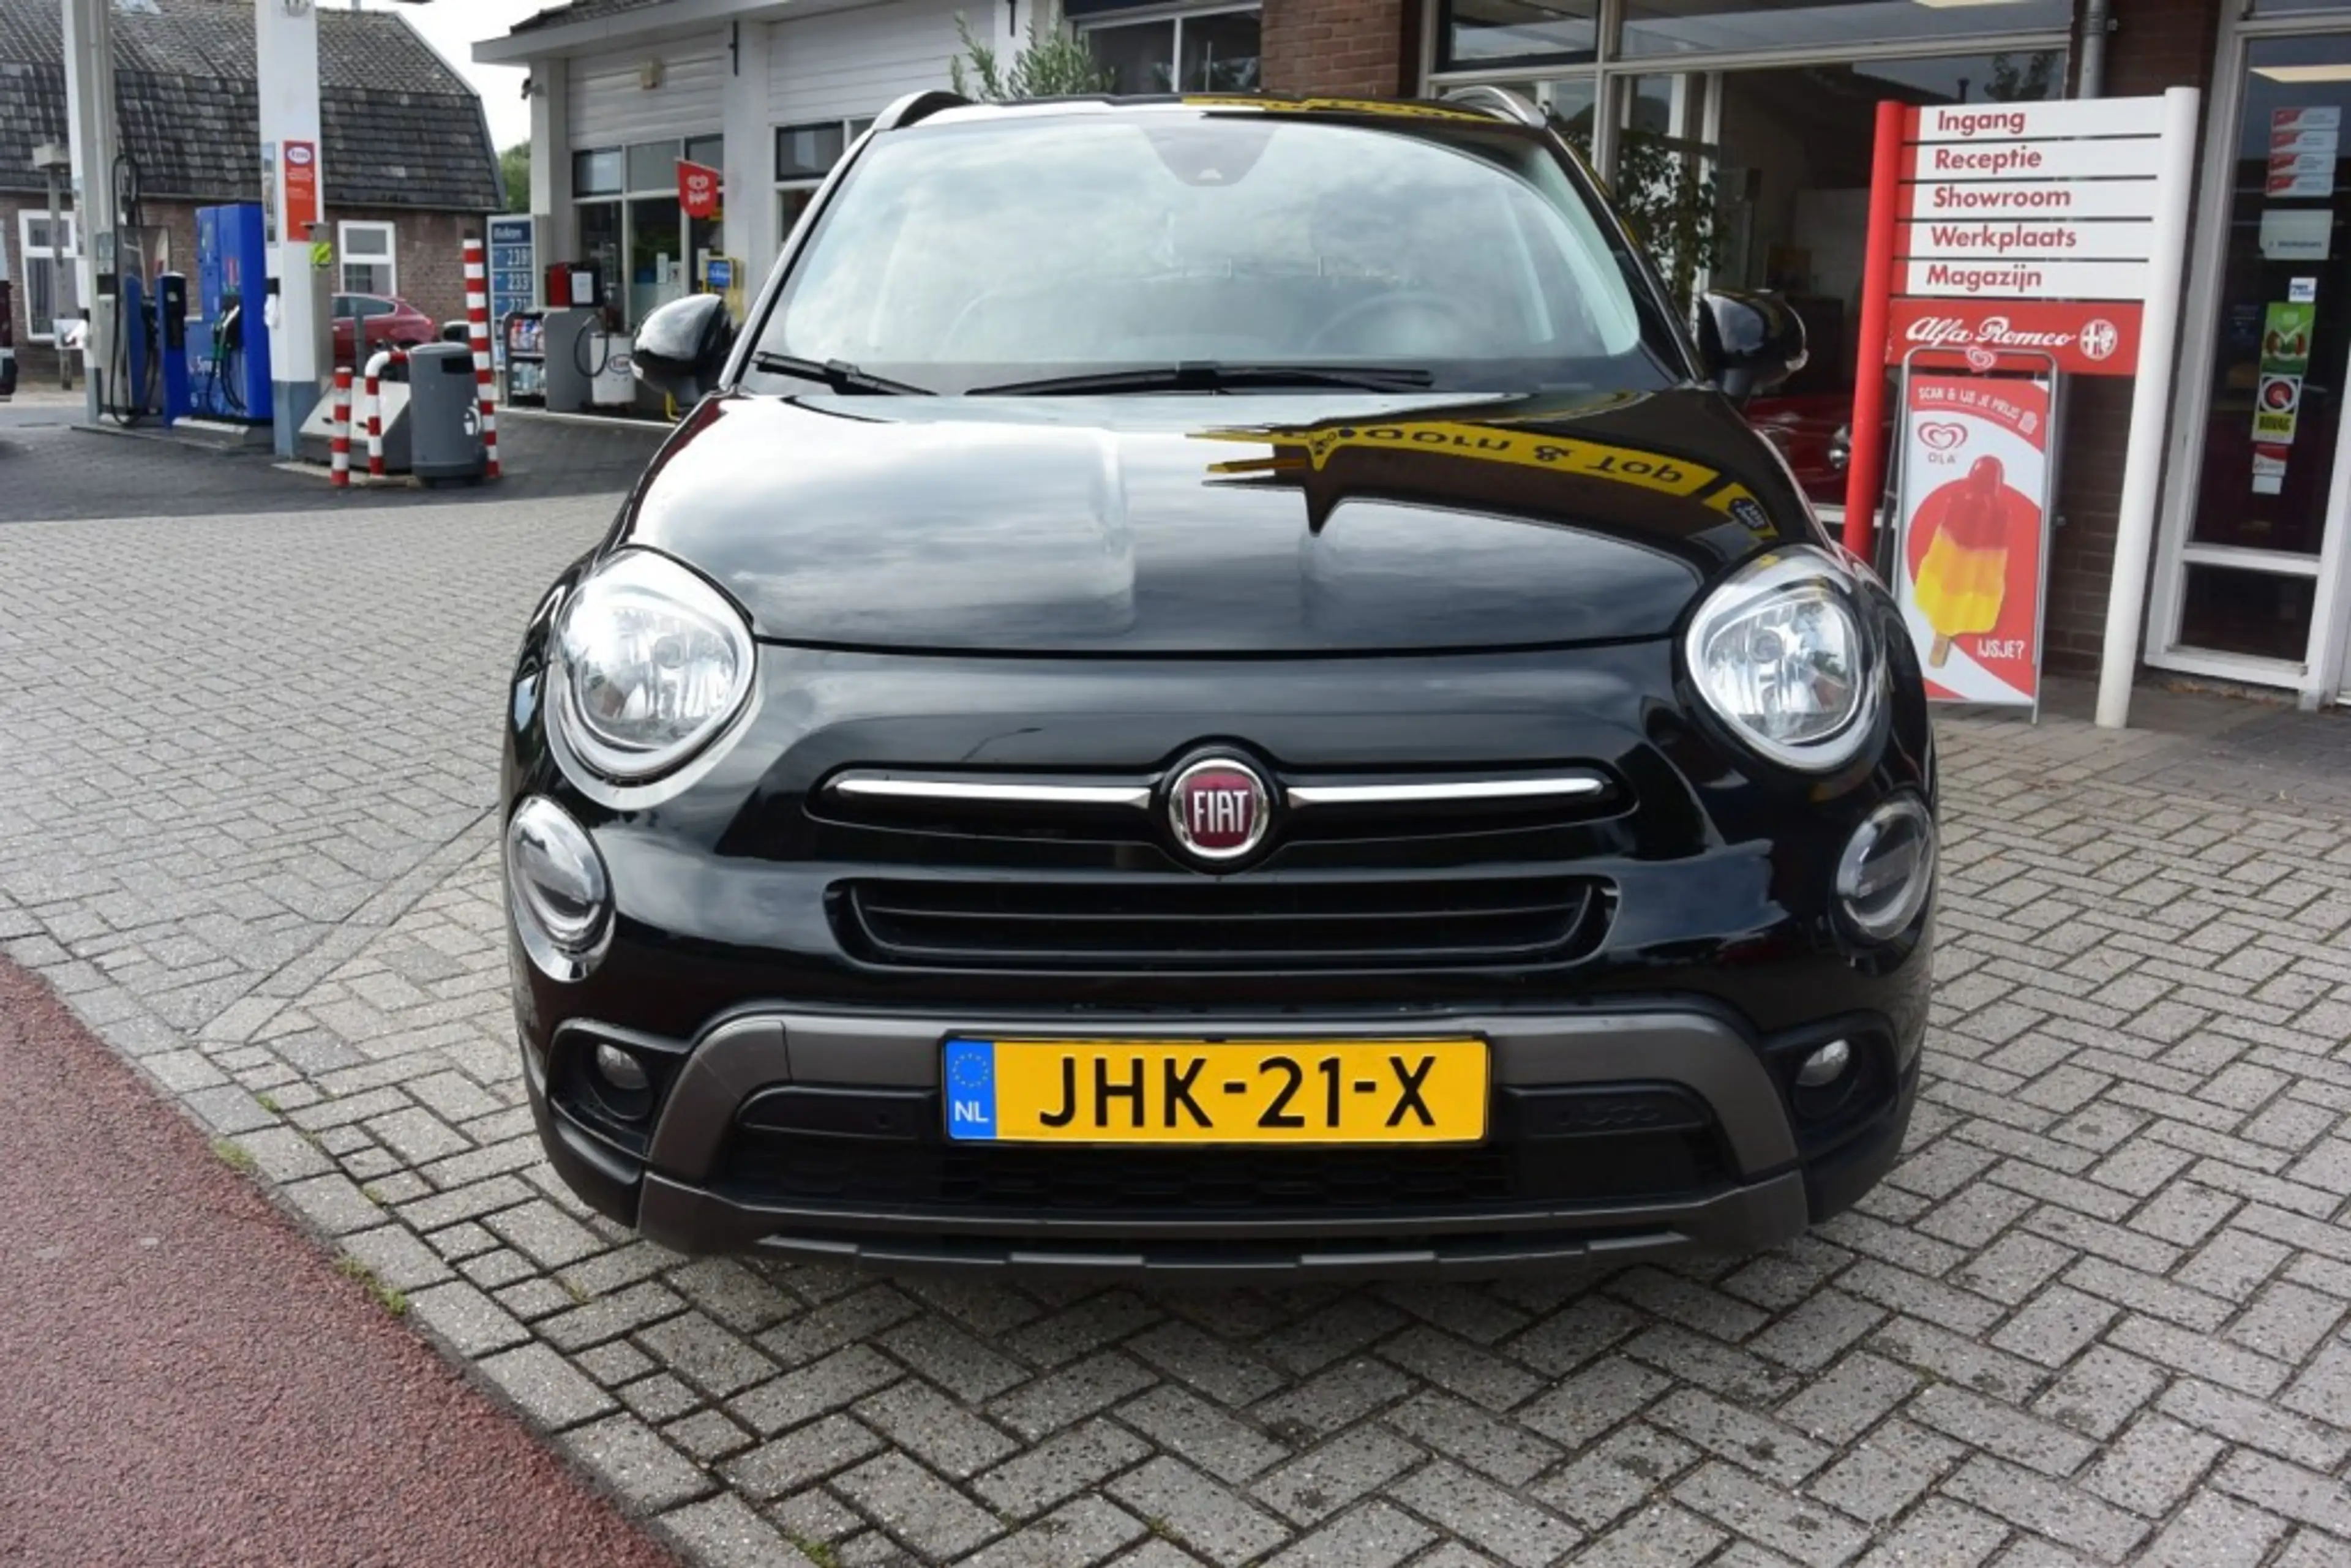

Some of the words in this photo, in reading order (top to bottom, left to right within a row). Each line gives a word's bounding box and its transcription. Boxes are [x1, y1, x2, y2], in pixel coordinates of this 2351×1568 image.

[1938, 111, 2025, 135] Ingang
[1935, 146, 2042, 174] Receptie
[1933, 187, 2072, 208] Showroom
[1930, 225, 2077, 253] Werkplaats
[1926, 264, 2042, 292] Magazijn
[1905, 316, 1974, 347] Alfa
[1974, 316, 2077, 347] Romeo
[1918, 386, 1944, 401] SCAN
[1927, 452, 1956, 464] OLA
[1976, 639, 2025, 659] IJSJE?
[1193, 789, 1249, 833] FIAT
[954, 1101, 989, 1123] NL
[1039, 1056, 1437, 1128] JHK-21-X
